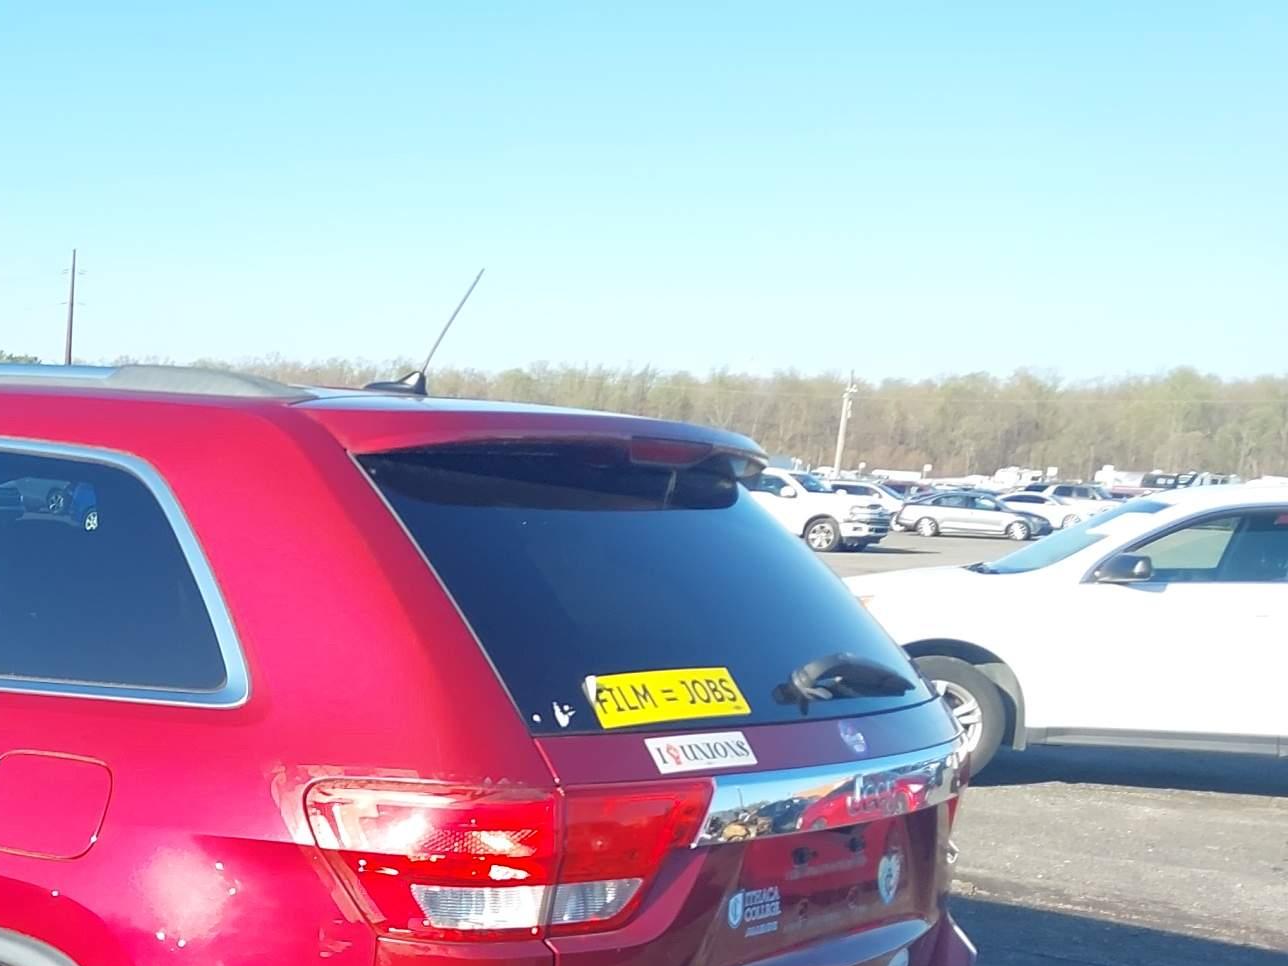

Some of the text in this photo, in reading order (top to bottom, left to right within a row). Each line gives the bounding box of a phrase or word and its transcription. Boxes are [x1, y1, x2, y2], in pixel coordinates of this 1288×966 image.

[596, 683, 659, 714] FILM
[680, 677, 738, 705] JOBS
[655, 739, 751, 765] I UNIONS
